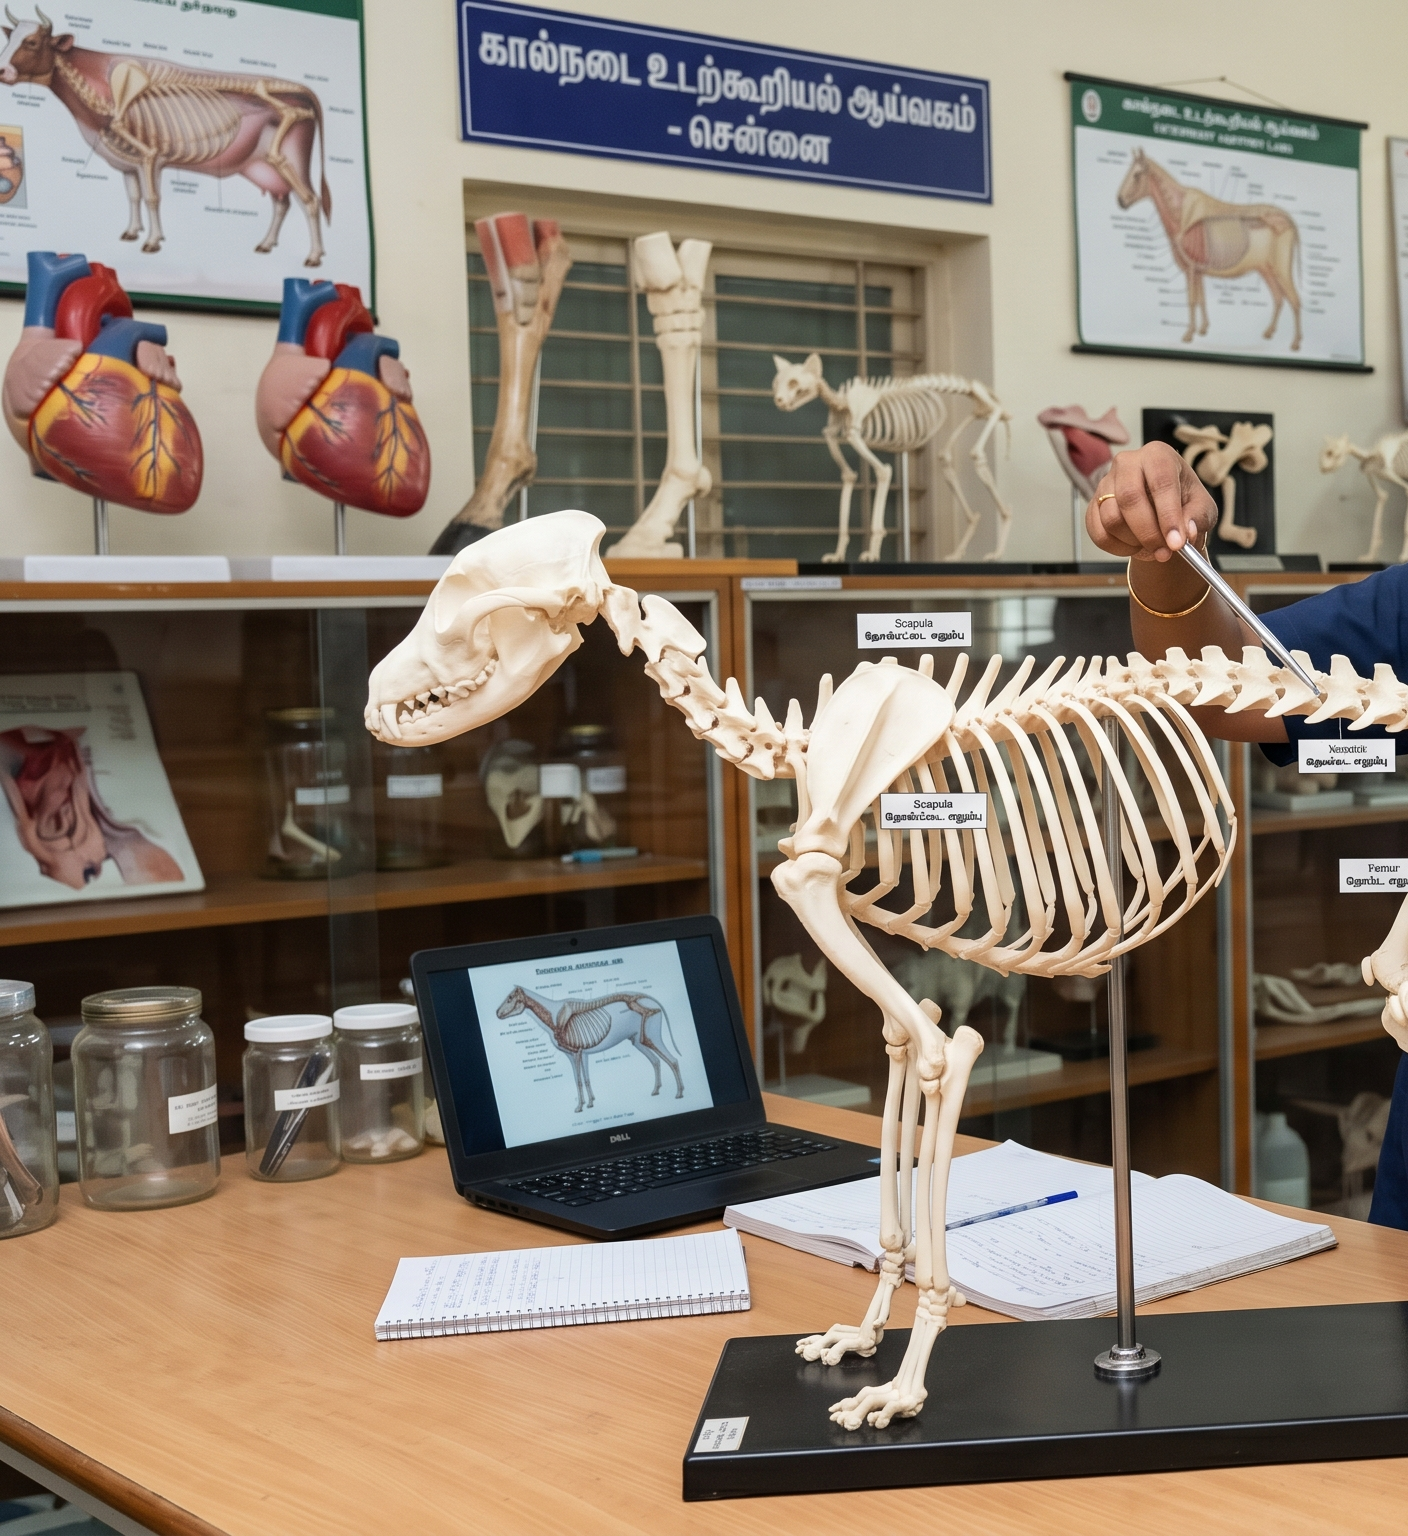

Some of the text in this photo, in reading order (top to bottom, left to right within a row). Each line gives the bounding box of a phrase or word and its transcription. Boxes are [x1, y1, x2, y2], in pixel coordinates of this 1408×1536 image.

[479, 29, 976, 134] கால்நடை உடற்கூறியல் ஆய்வகம்
[688, 115, 831, 165] சென்னை
[895, 619, 933, 630] Scapula
[914, 800, 953, 810] Scapula
[1368, 864, 1400, 872] Femur
[610, 1133, 631, 1143] DELL
